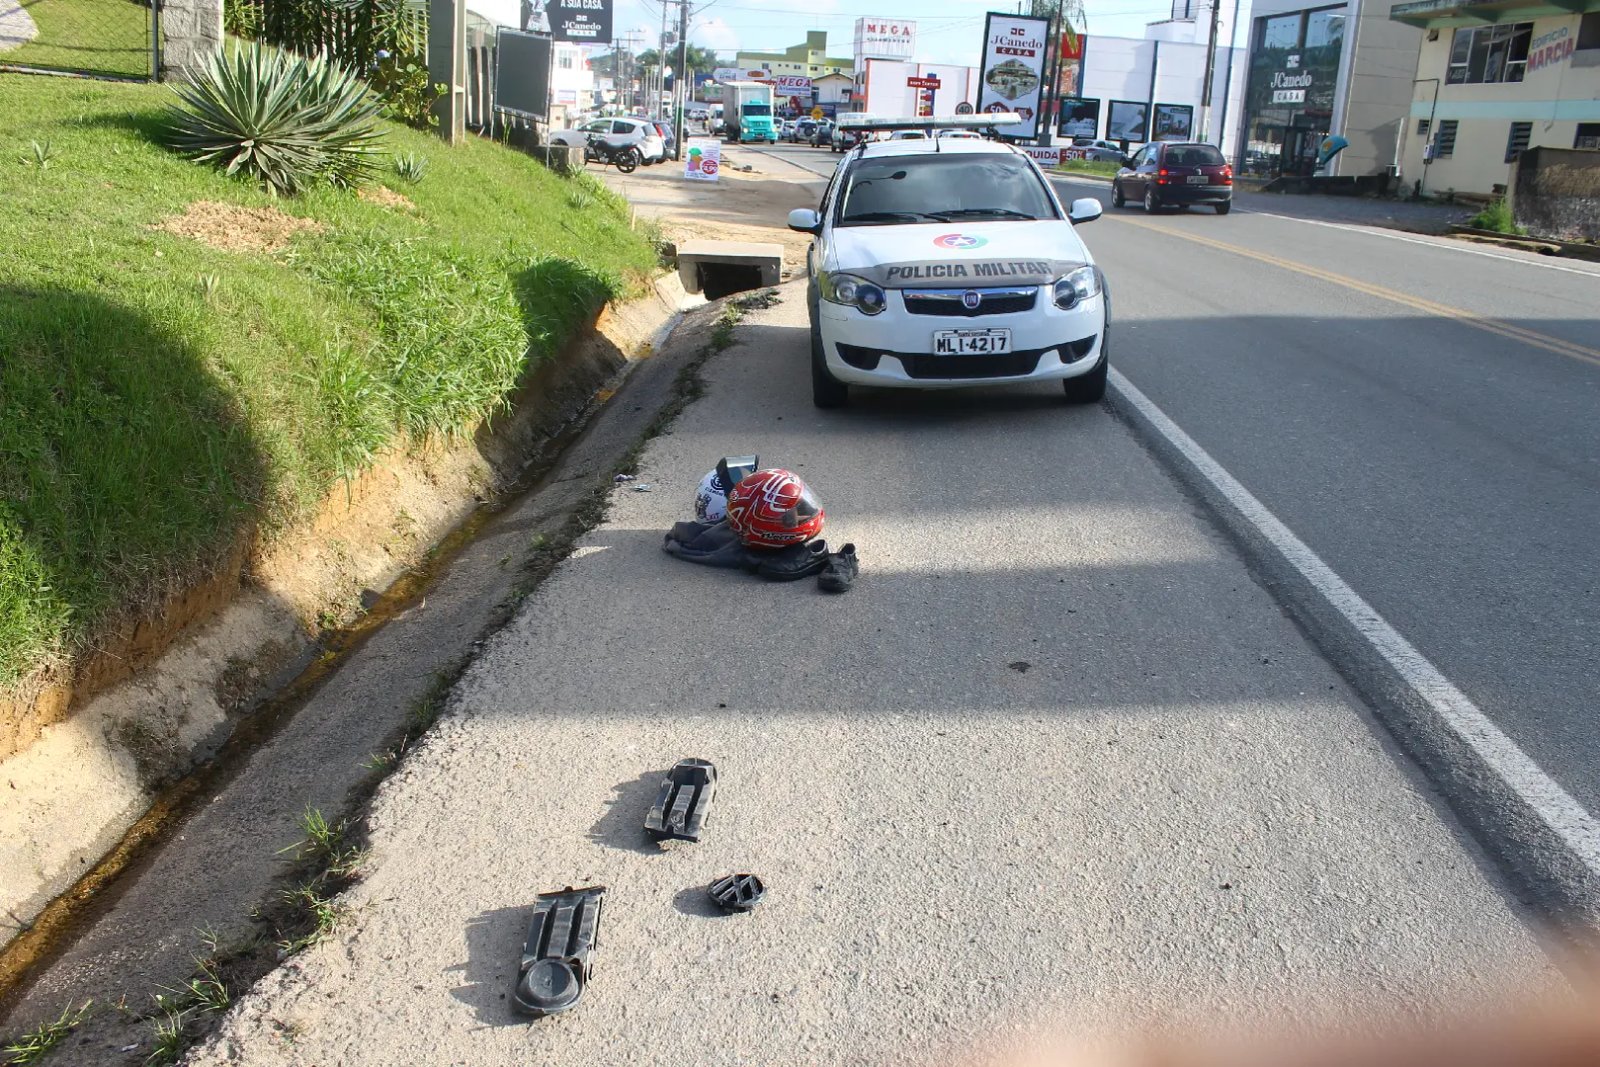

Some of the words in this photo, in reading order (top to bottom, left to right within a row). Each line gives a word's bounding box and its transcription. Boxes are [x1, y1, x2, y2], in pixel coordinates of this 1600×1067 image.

[562, 20, 602, 31] JCanedo
[867, 24, 910, 36] MEGA
[990, 35, 1042, 49] JCanedo
[1001, 48, 1030, 56] CASA
[1527, 37, 1573, 73] MARCIA
[778, 77, 811, 87] MEGA
[1270, 69, 1312, 88] JCanedo
[1277, 91, 1300, 100] CASA
[886, 264, 968, 280] POLICIA
[973, 261, 1053, 277] MILITAR
